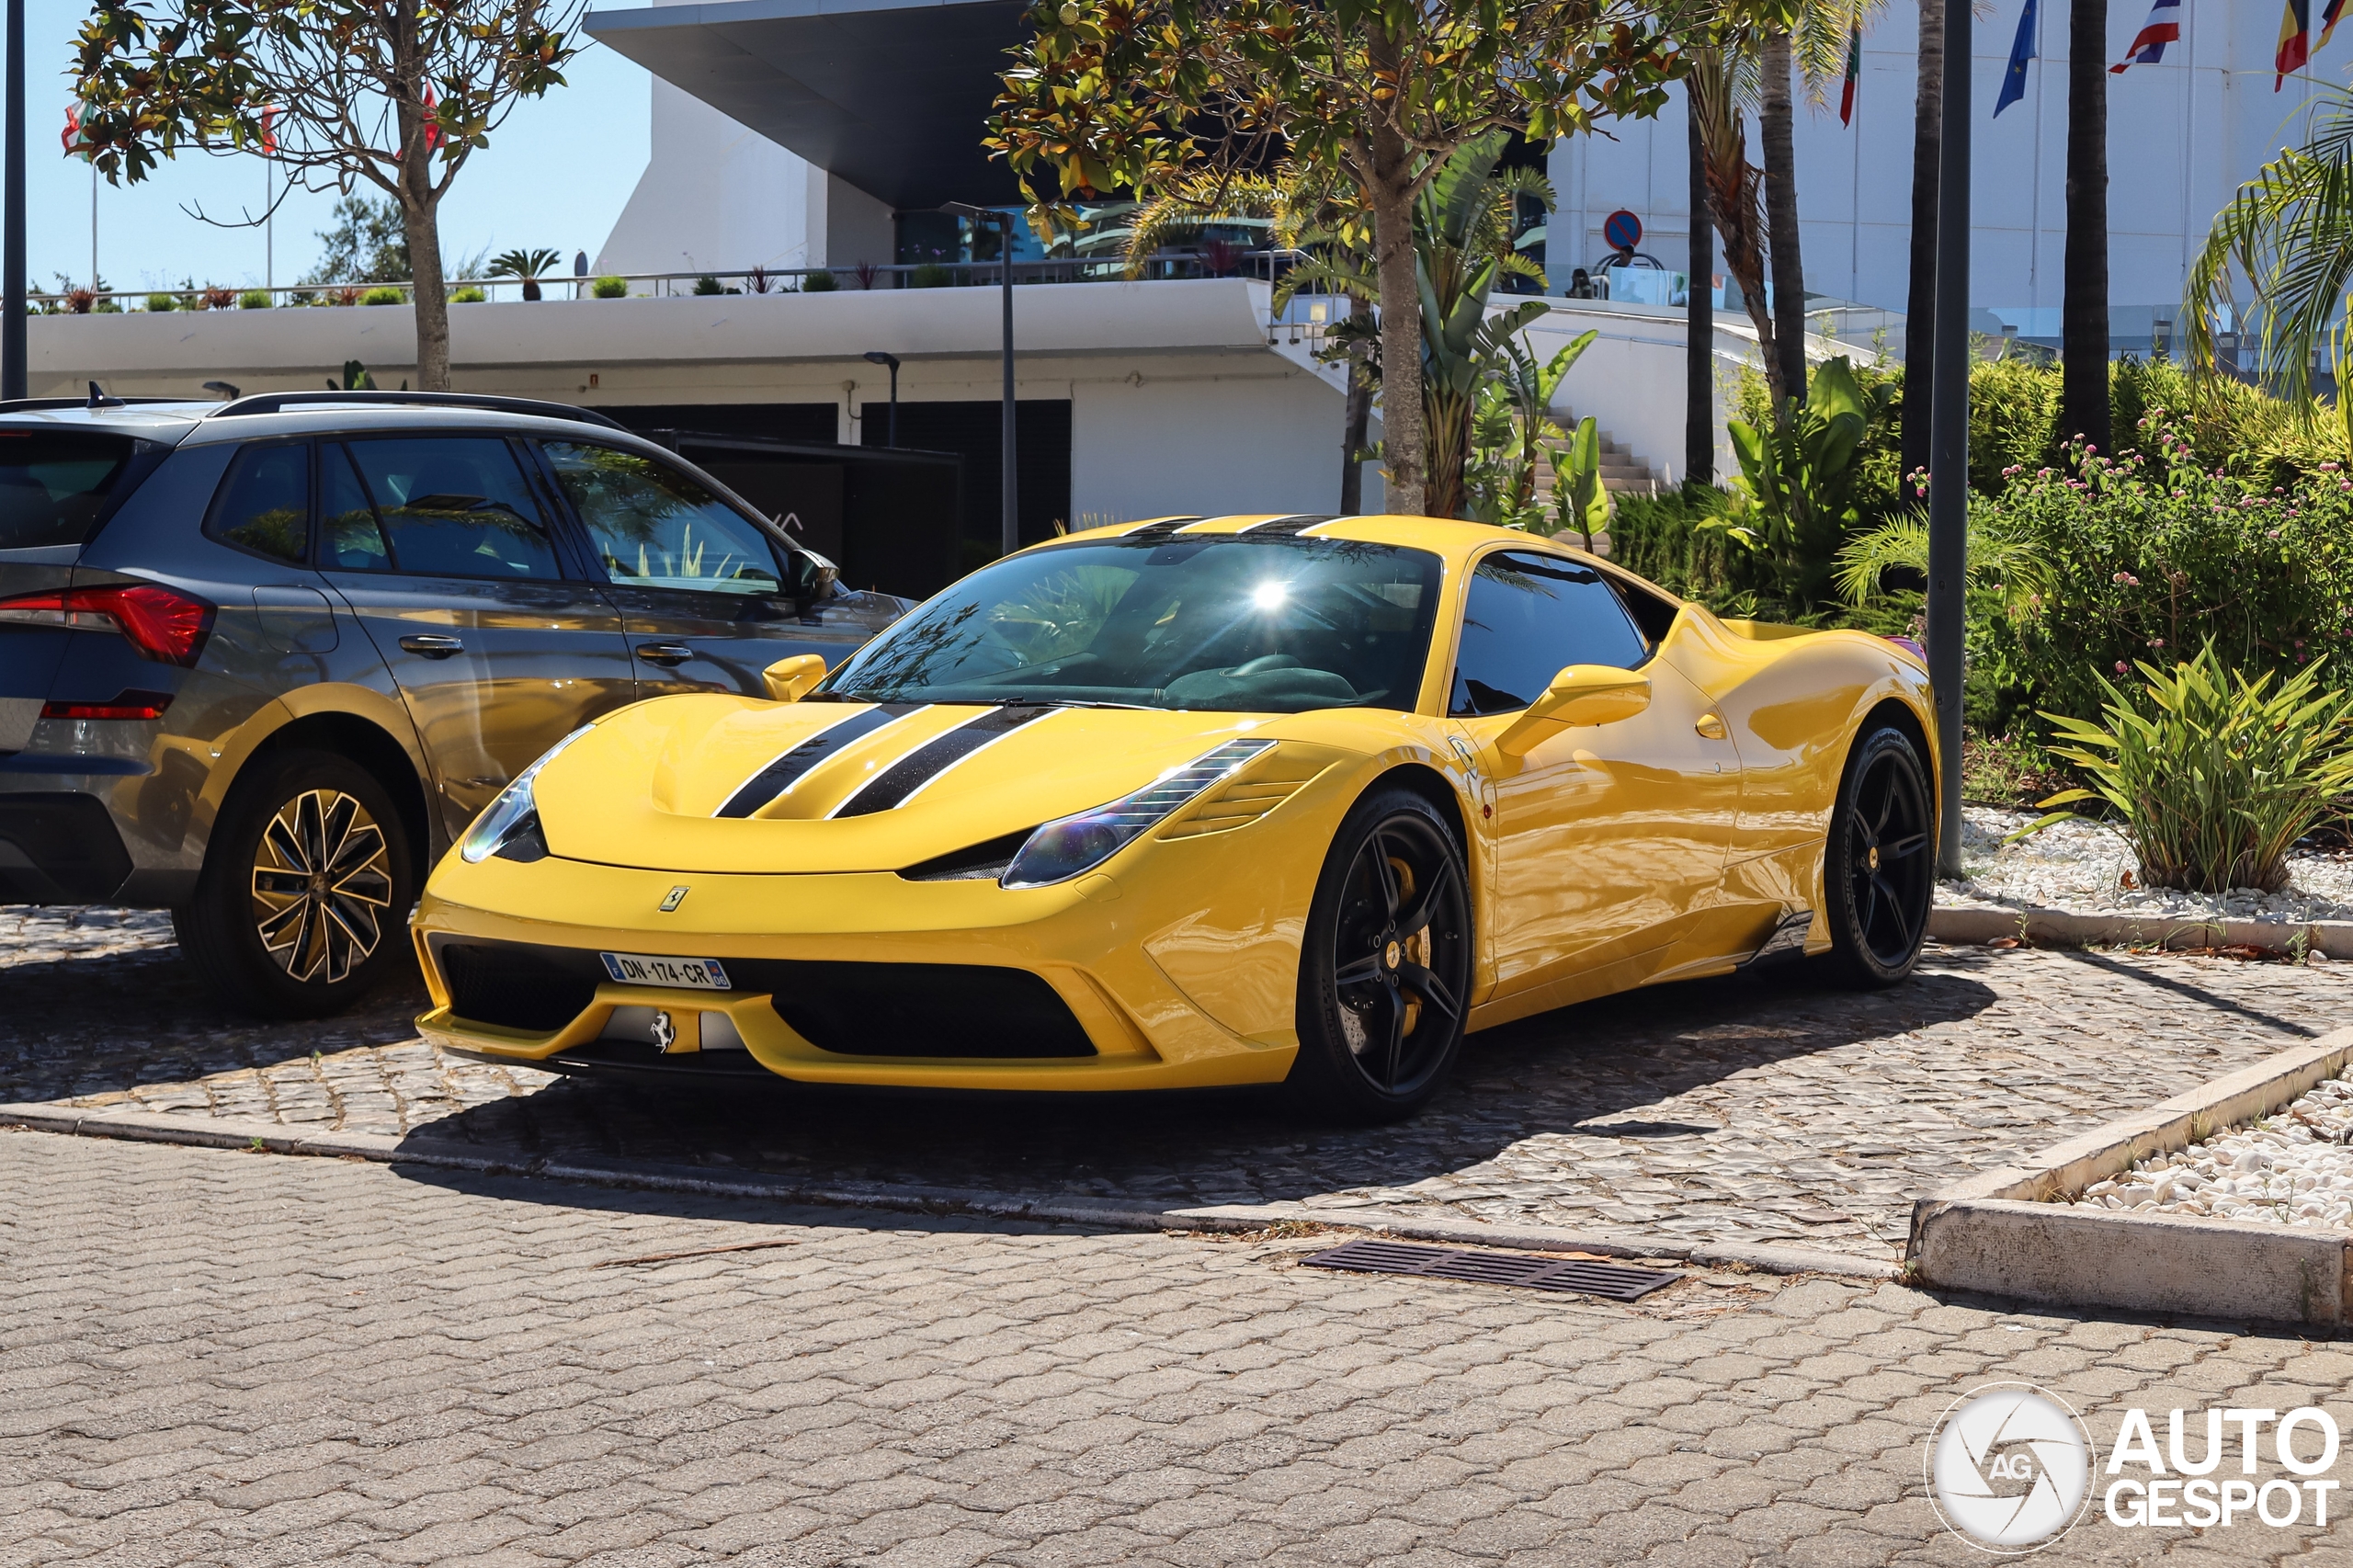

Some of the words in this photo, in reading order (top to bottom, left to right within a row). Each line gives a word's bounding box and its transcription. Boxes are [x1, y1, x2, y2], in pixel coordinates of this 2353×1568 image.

[612, 967, 620, 976] F
[620, 959, 710, 983] DN-174-CR
[712, 975, 727, 986] 06
